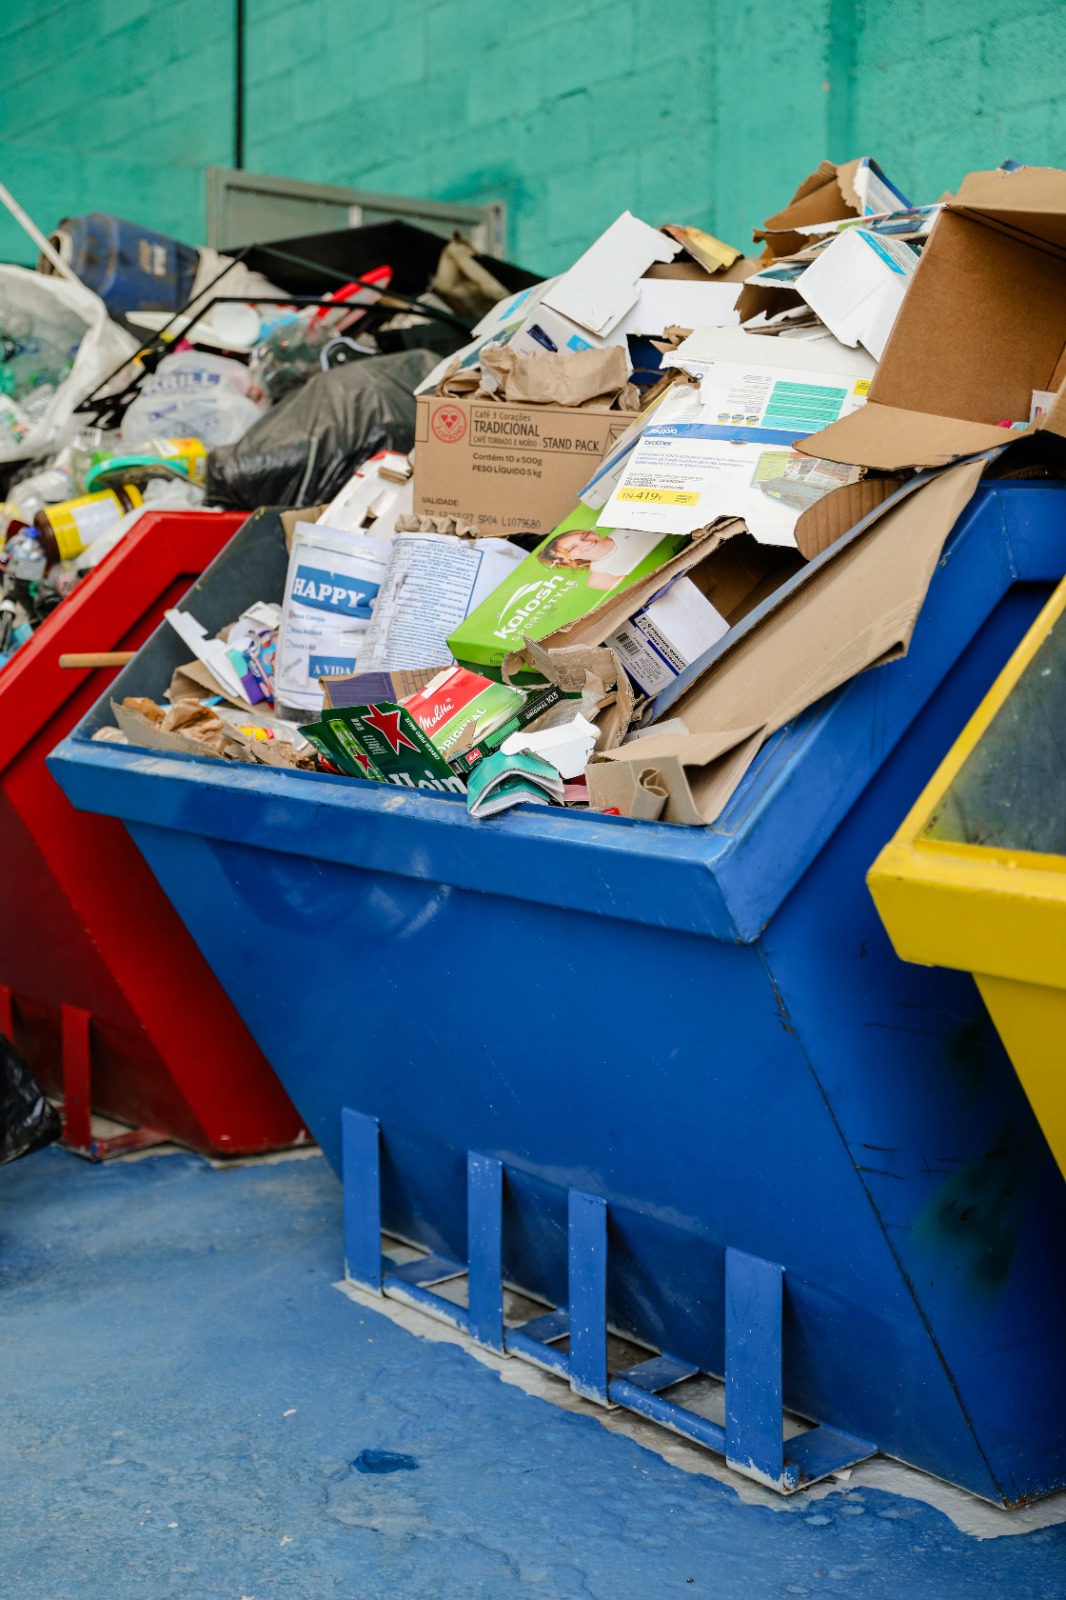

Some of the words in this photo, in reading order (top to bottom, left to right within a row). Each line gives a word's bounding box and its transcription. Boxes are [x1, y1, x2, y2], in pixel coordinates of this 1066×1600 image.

[475, 410, 490, 419] Café
[493, 411, 497, 419] 3
[499, 412, 531, 422] Corações
[473, 420, 540, 437] TRADICIONAL
[473, 435, 486, 444] CAFÉ
[487, 437, 512, 446] TORRADO
[519, 438, 537, 447] MOÍDO
[543, 437, 572, 450] STAND
[575, 438, 600, 452] PACK
[473, 452, 504, 462] Contém
[505, 455, 515, 463] 10
[522, 456, 543, 467] 500g
[472, 464, 493, 473] PESO
[494, 464, 526, 475] LÍQUIDO
[533, 469, 542, 478] kg
[292, 578, 366, 608] HAPPY
[494, 574, 565, 639] kolosh
[313, 664, 321, 674] A
[323, 664, 351, 675] VIDA
[546, 692, 559, 705] 103
[419, 703, 455, 730] Melitta
